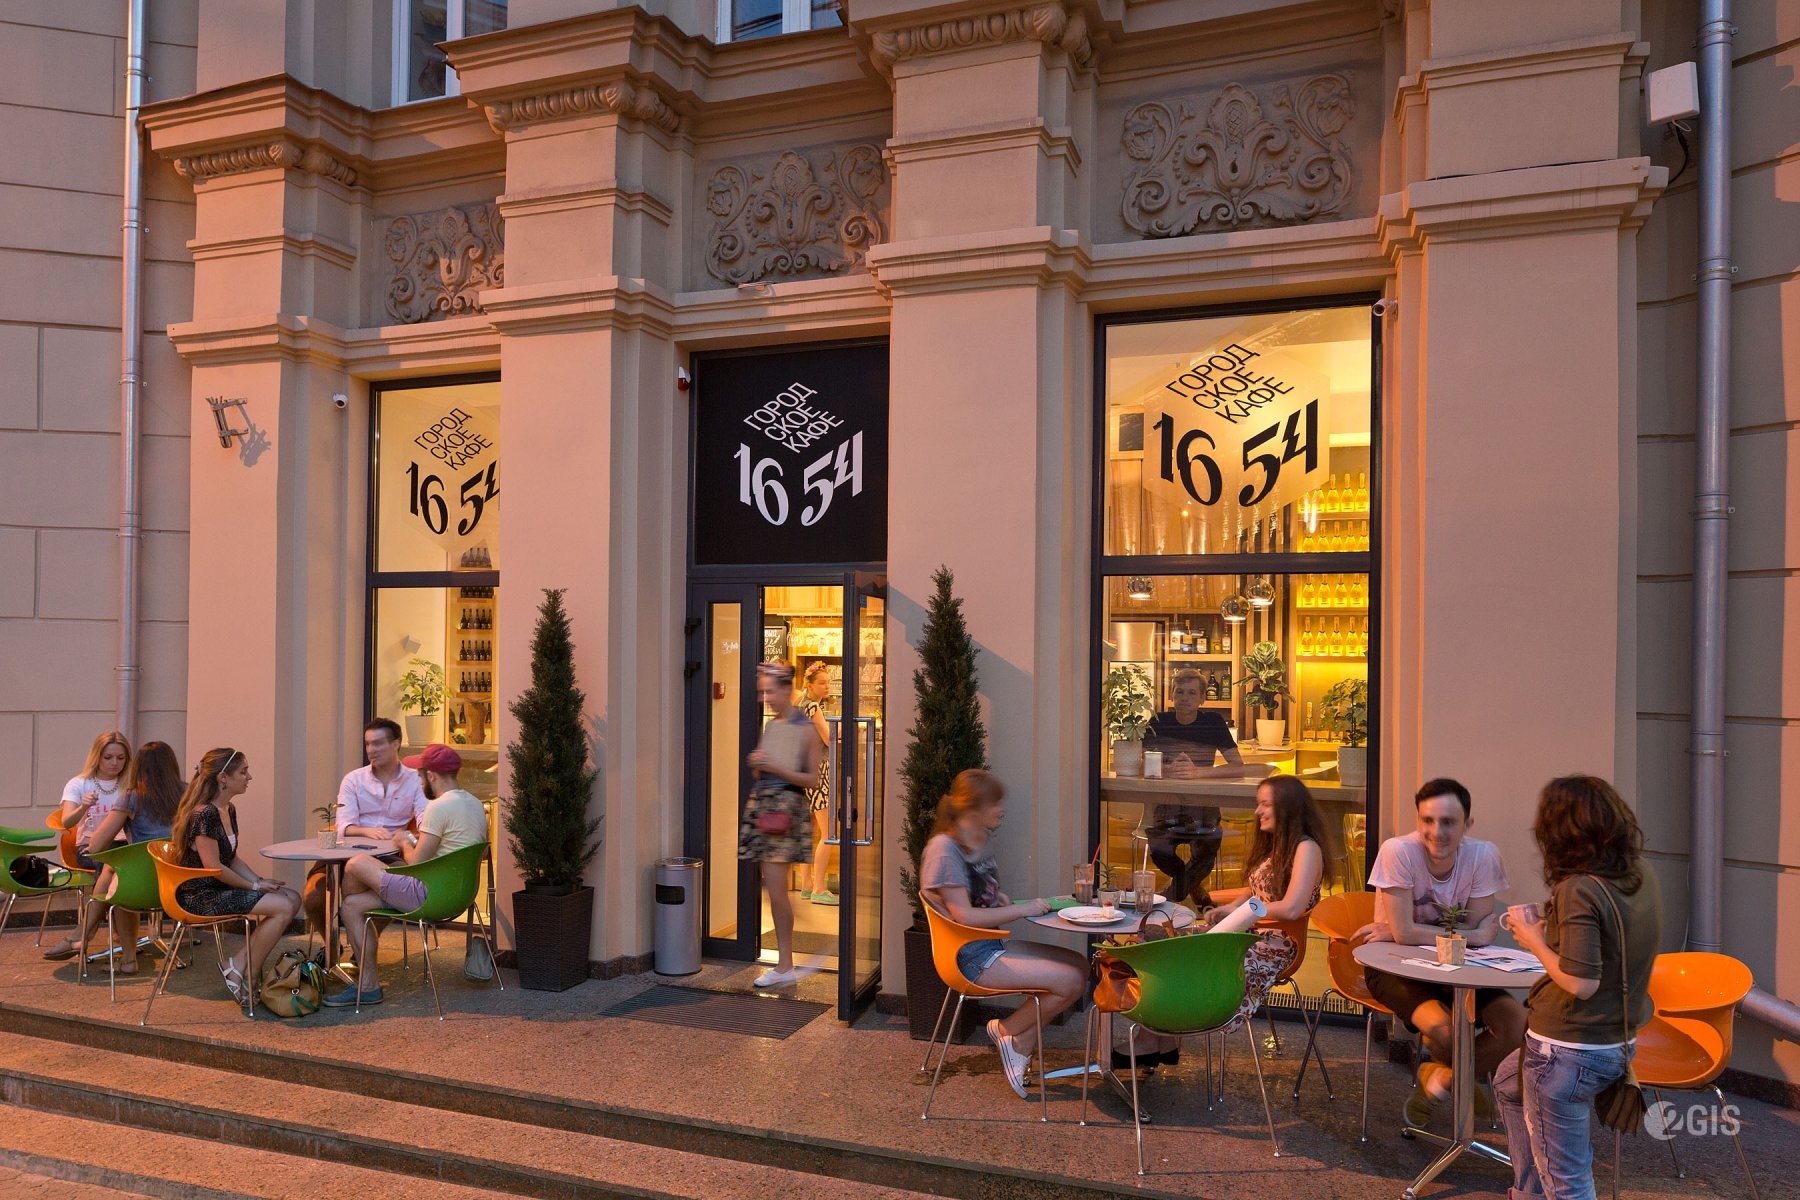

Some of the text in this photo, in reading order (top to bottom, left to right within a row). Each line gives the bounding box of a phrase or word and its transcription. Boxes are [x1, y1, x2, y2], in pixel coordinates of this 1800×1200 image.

[1165, 343, 1260, 398] ГОРОД
[1192, 366, 1265, 411] СКОЕ
[743, 382, 818, 431] ГОРОД
[764, 402, 821, 441] СКОЕ
[1214, 376, 1295, 424] КАФЕ
[413, 407, 473, 450] ГОРОД
[430, 425, 475, 460] СКОЕ
[782, 410, 845, 454] КАФЕ
[444, 434, 494, 471] КАФЕ
